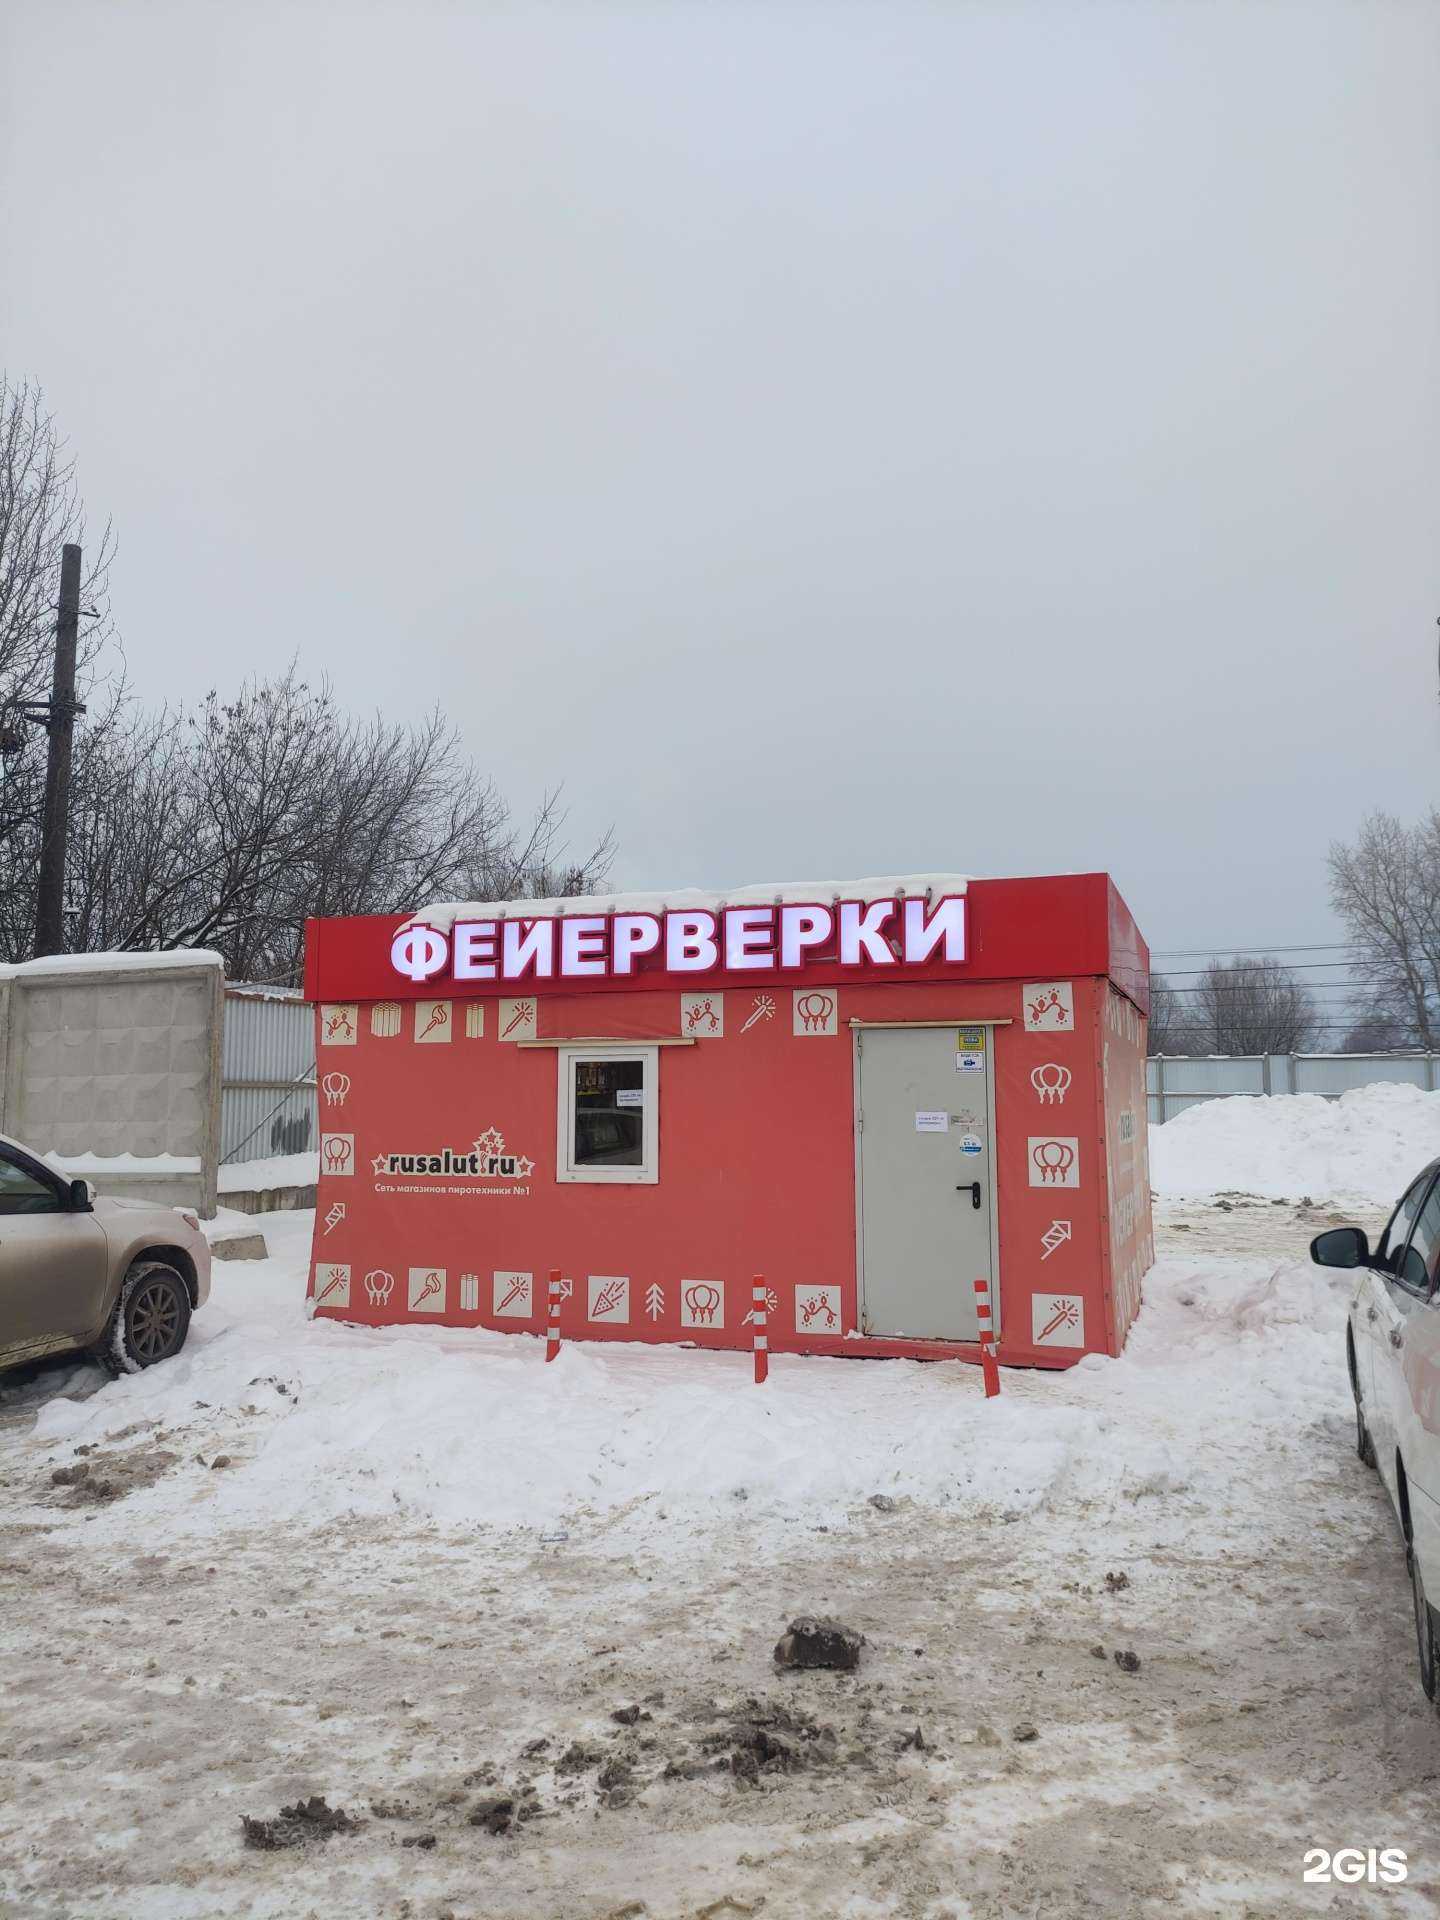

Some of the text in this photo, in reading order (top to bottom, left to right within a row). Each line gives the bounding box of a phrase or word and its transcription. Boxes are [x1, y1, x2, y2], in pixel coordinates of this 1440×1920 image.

[390, 898, 967, 982] ФЕЙЕРВЕРКИ
[374, 1183, 529, 1195] Сеть магазинов пиротехники №1
